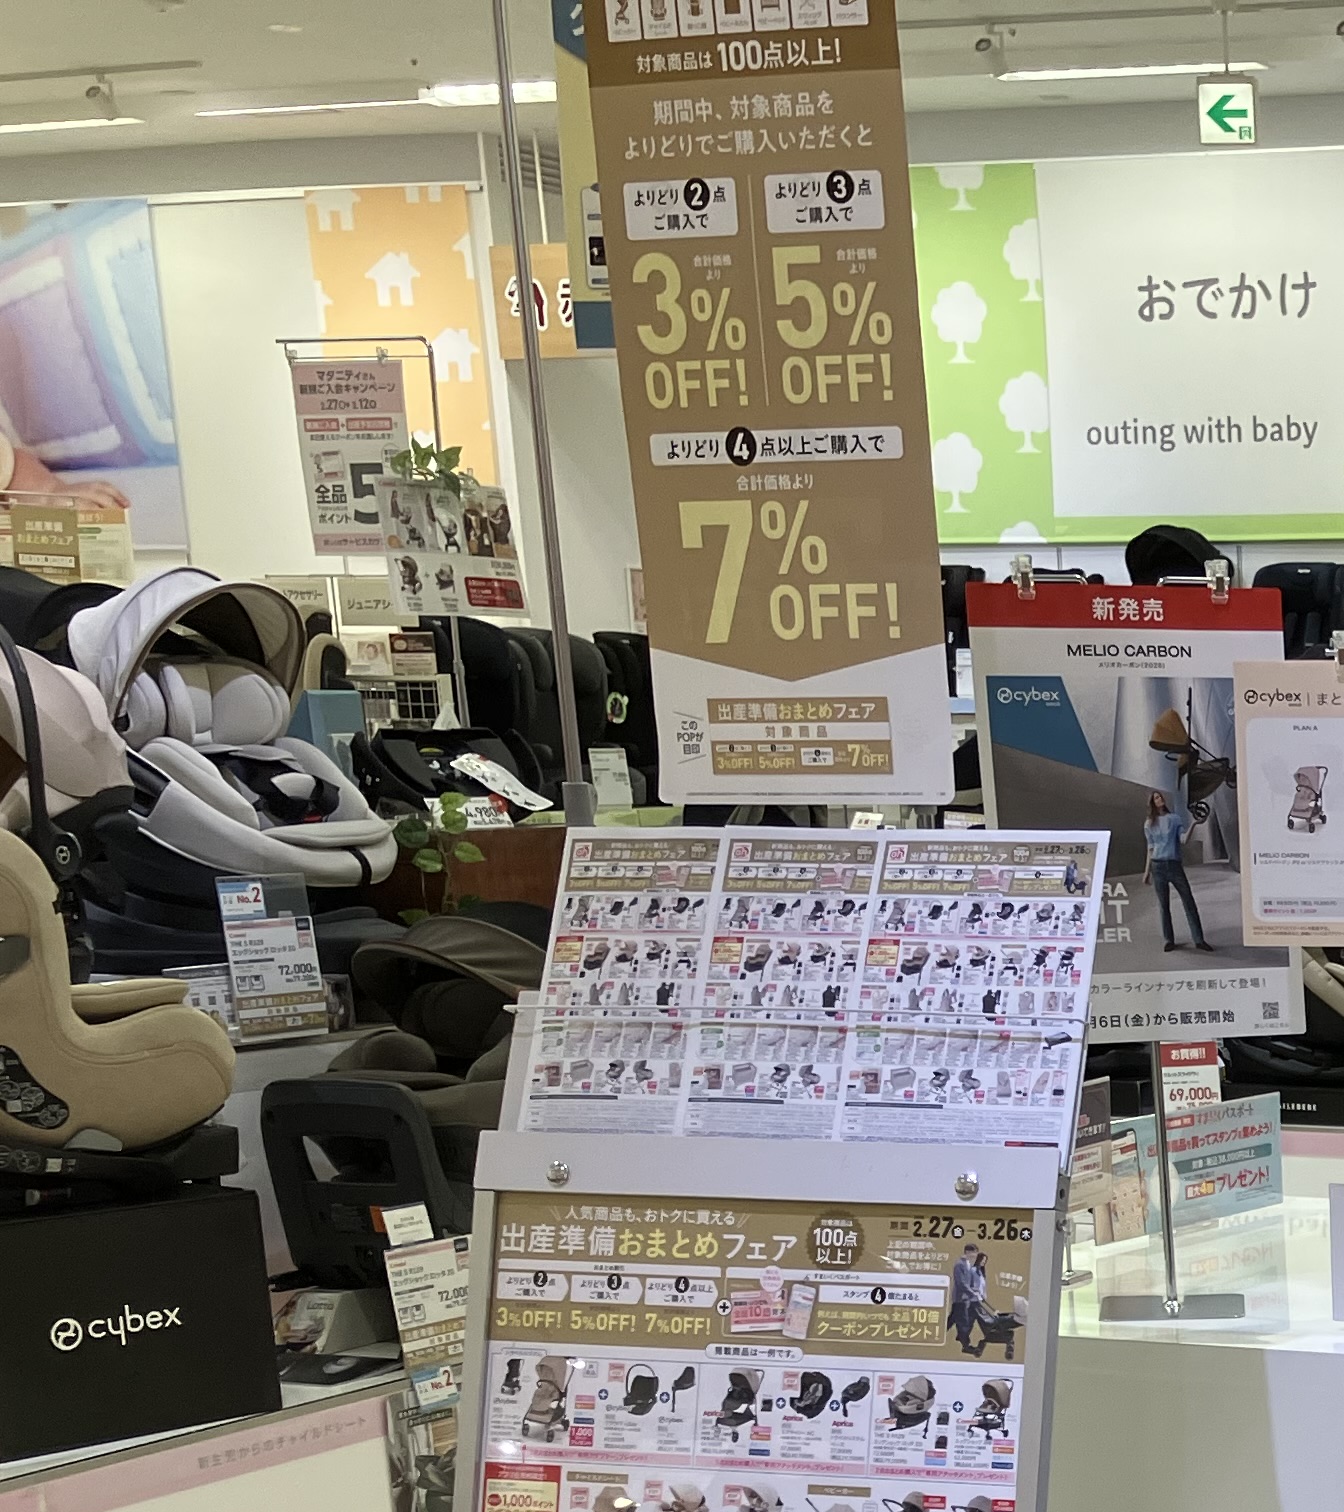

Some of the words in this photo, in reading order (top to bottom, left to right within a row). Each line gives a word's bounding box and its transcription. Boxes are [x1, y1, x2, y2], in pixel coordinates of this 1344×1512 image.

[653, 90, 834, 126] 期間中、対象商品を
[624, 124, 873, 160] よりどりでご購入いただくと
[654, 214, 709, 231] ご購入で
[796, 206, 853, 225] ご購入で
[632, 252, 746, 355] 3%
[771, 245, 893, 350] 5%
[1137, 271, 1317, 322] おでかけ
[645, 358, 748, 409] OFF!
[782, 353, 894, 405] OFF!
[1086, 418, 1175, 452] outing
[1184, 415, 1242, 444] with
[1252, 415, 1318, 448] baby
[667, 427, 885, 466] よりどり4点以上ご購入で
[736, 474, 814, 491] 合計価格より
[679, 500, 828, 644] 7%
[769, 583, 901, 641] OFF!
[1091, 597, 1165, 622] 新発売
[1066, 644, 1119, 657] MELIO
[1124, 645, 1192, 658] CARBON
[1012, 686, 1060, 704] cybex
[1259, 688, 1302, 707] cybex
[717, 702, 876, 721] 出産準備おまとめフェア
[565, 1206, 736, 1226] 人気商品も、おトクに買える
[500, 1223, 798, 1262] 出産準備おまとめフェア
[813, 1227, 858, 1248] 100点
[816, 1248, 852, 1265] 以上!
[88, 1305, 181, 1346] cybex
[496, 1307, 561, 1328] 3%OFF!
[570, 1311, 635, 1333] 5%OFF!
[645, 1313, 710, 1335] 7%OFF!
